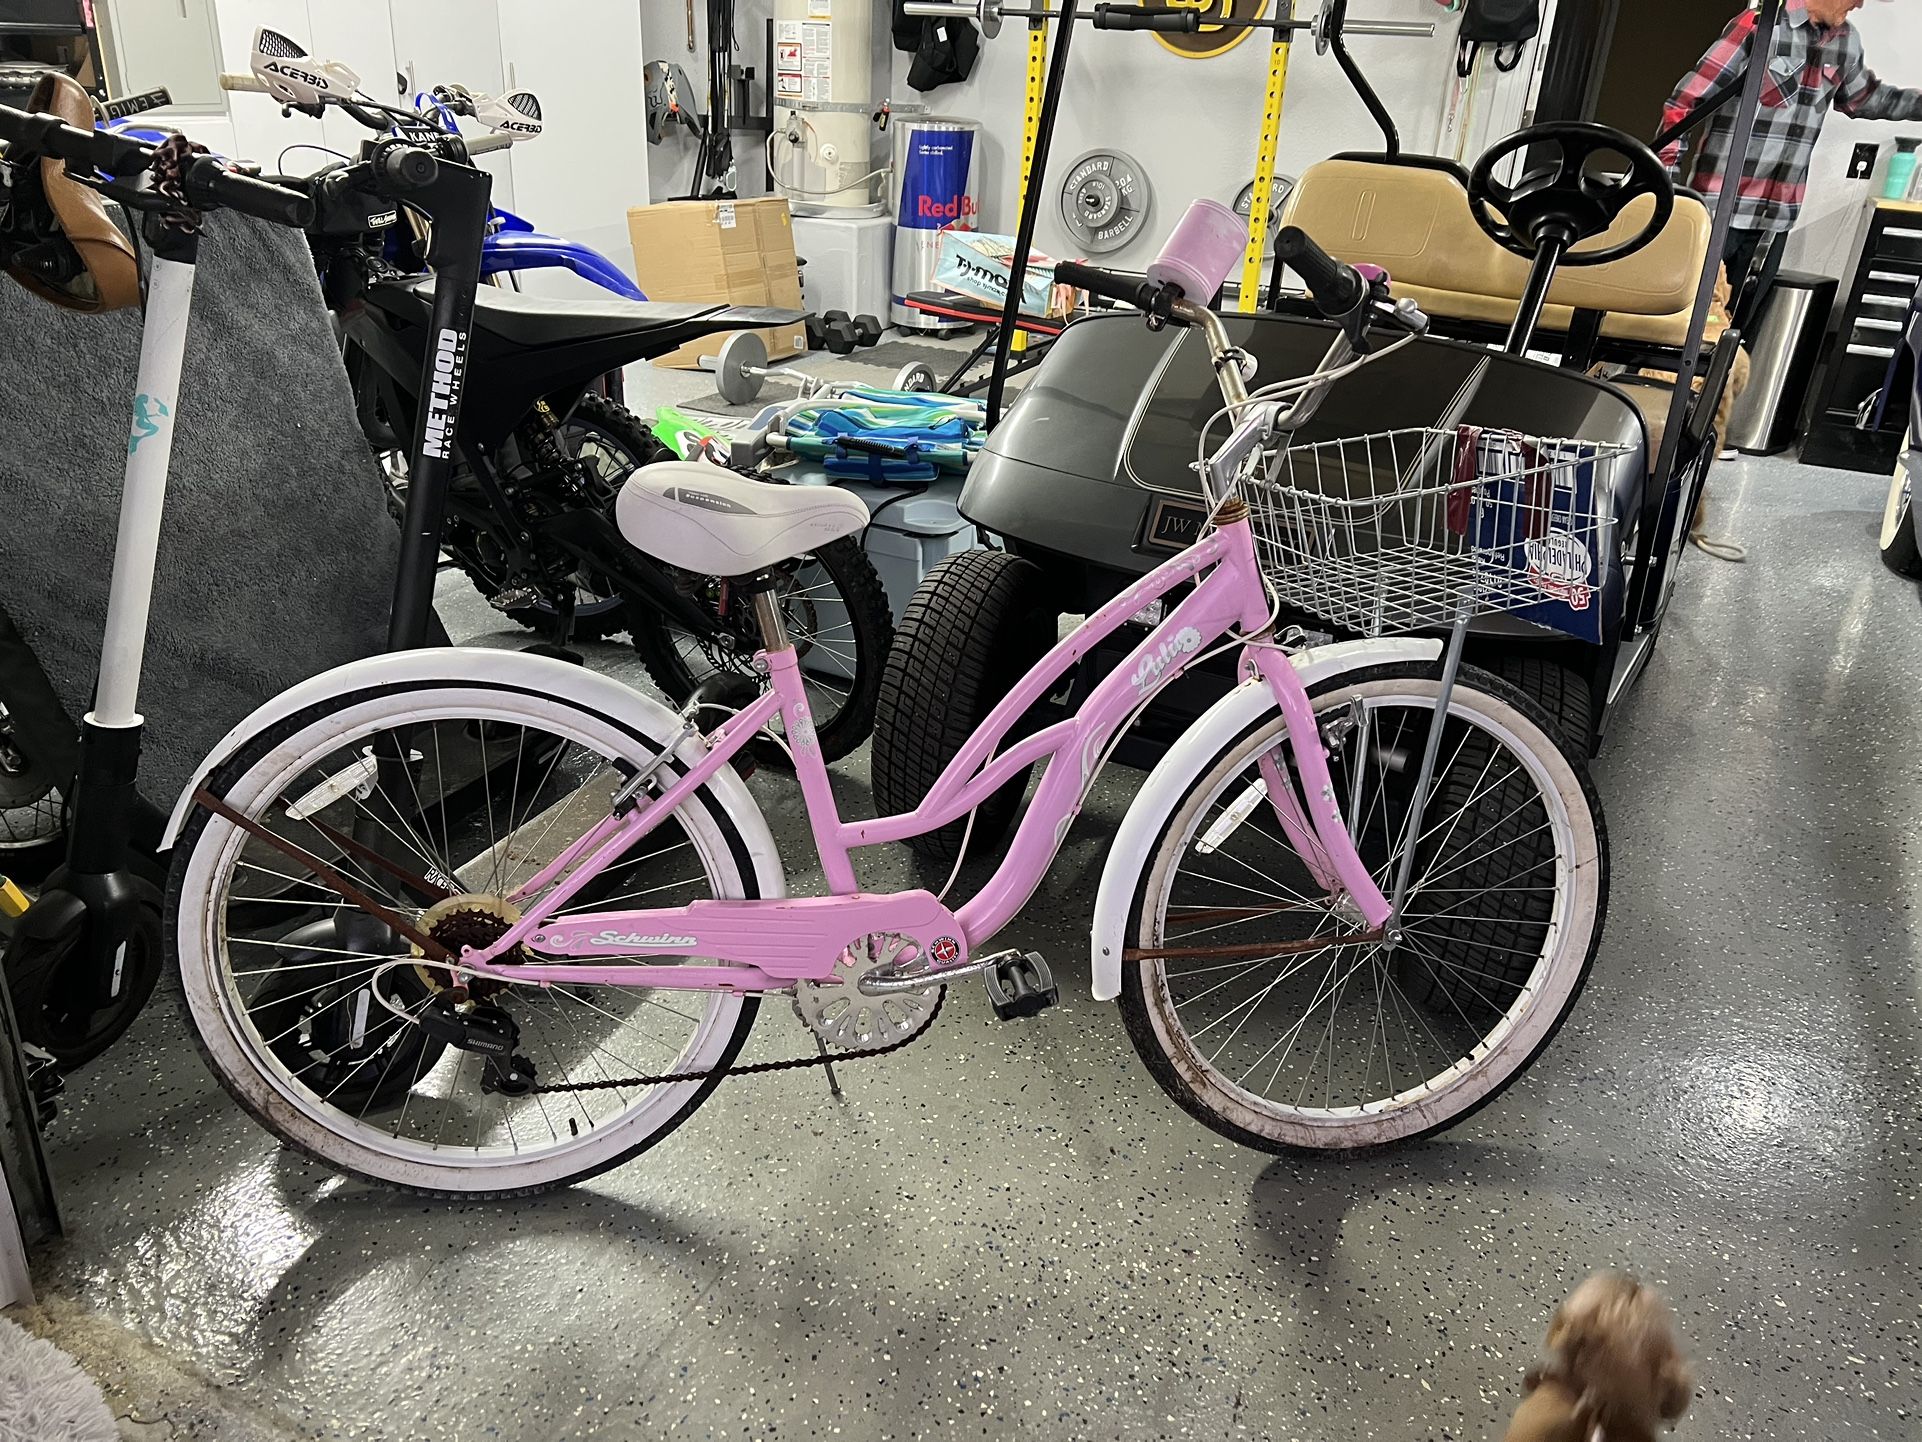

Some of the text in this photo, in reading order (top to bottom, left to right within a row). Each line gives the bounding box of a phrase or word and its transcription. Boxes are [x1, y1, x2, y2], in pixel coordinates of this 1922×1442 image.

[1070, 161, 1109, 190] STANDARD
[918, 194, 958, 217] Red
[1098, 215, 1134, 240] BARBELL
[423, 328, 457, 458] METHOD
[442, 332, 466, 459] RACE WHEELS
[1161, 516, 1191, 534] JW
[590, 930, 698, 948] Schwinn
[467, 1038, 504, 1051] SHIMANO
